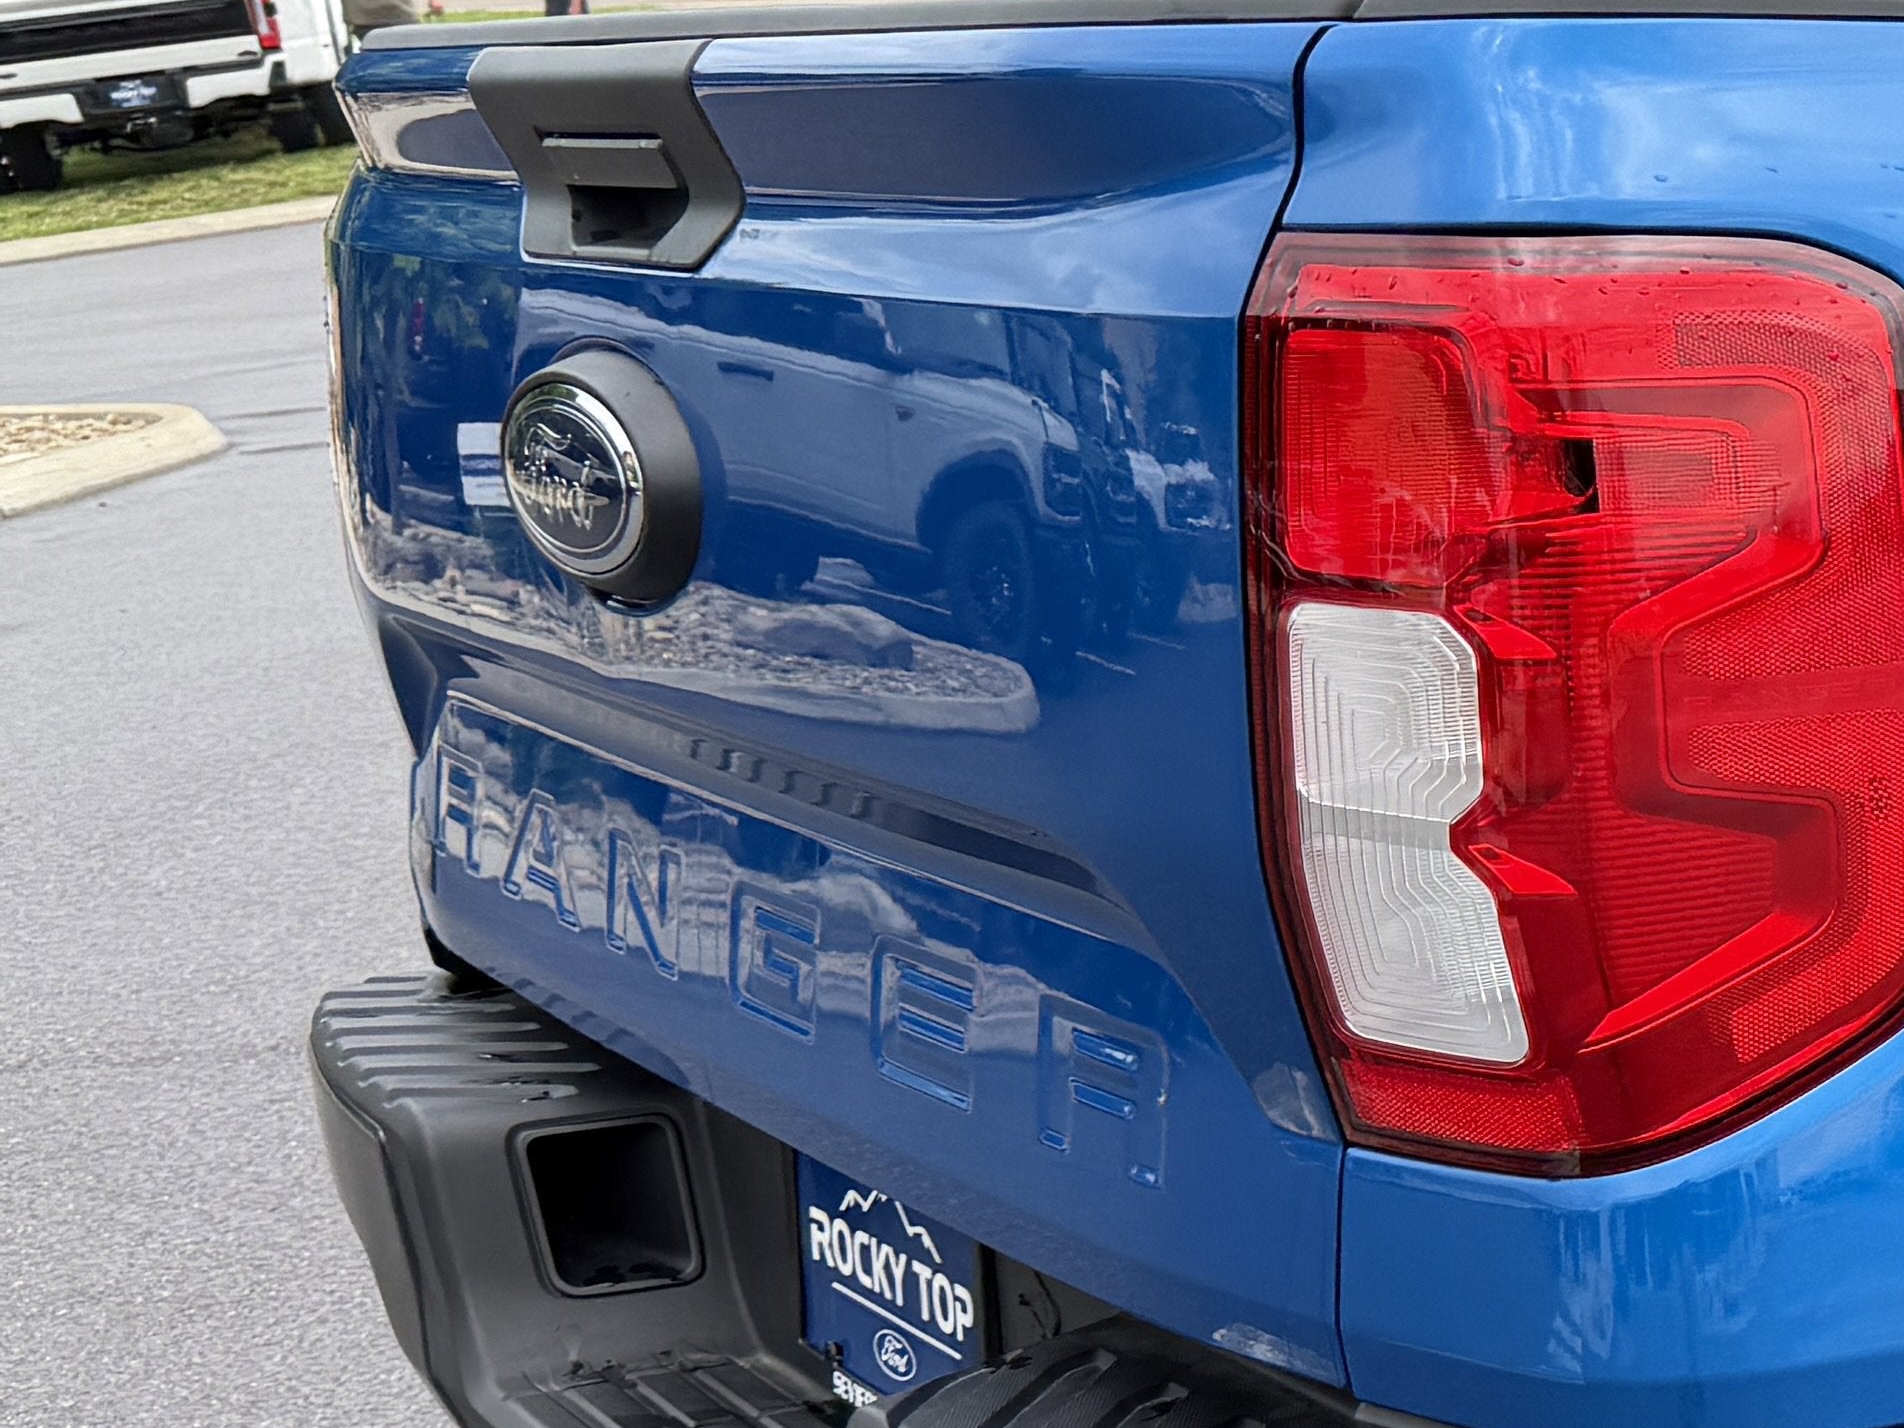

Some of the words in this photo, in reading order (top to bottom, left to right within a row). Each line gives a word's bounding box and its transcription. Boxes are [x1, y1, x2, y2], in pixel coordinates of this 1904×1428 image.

[434, 744, 1171, 1192] RANGER
[808, 1205, 907, 1307] ROCKY
[911, 1259, 974, 1342] TOP
